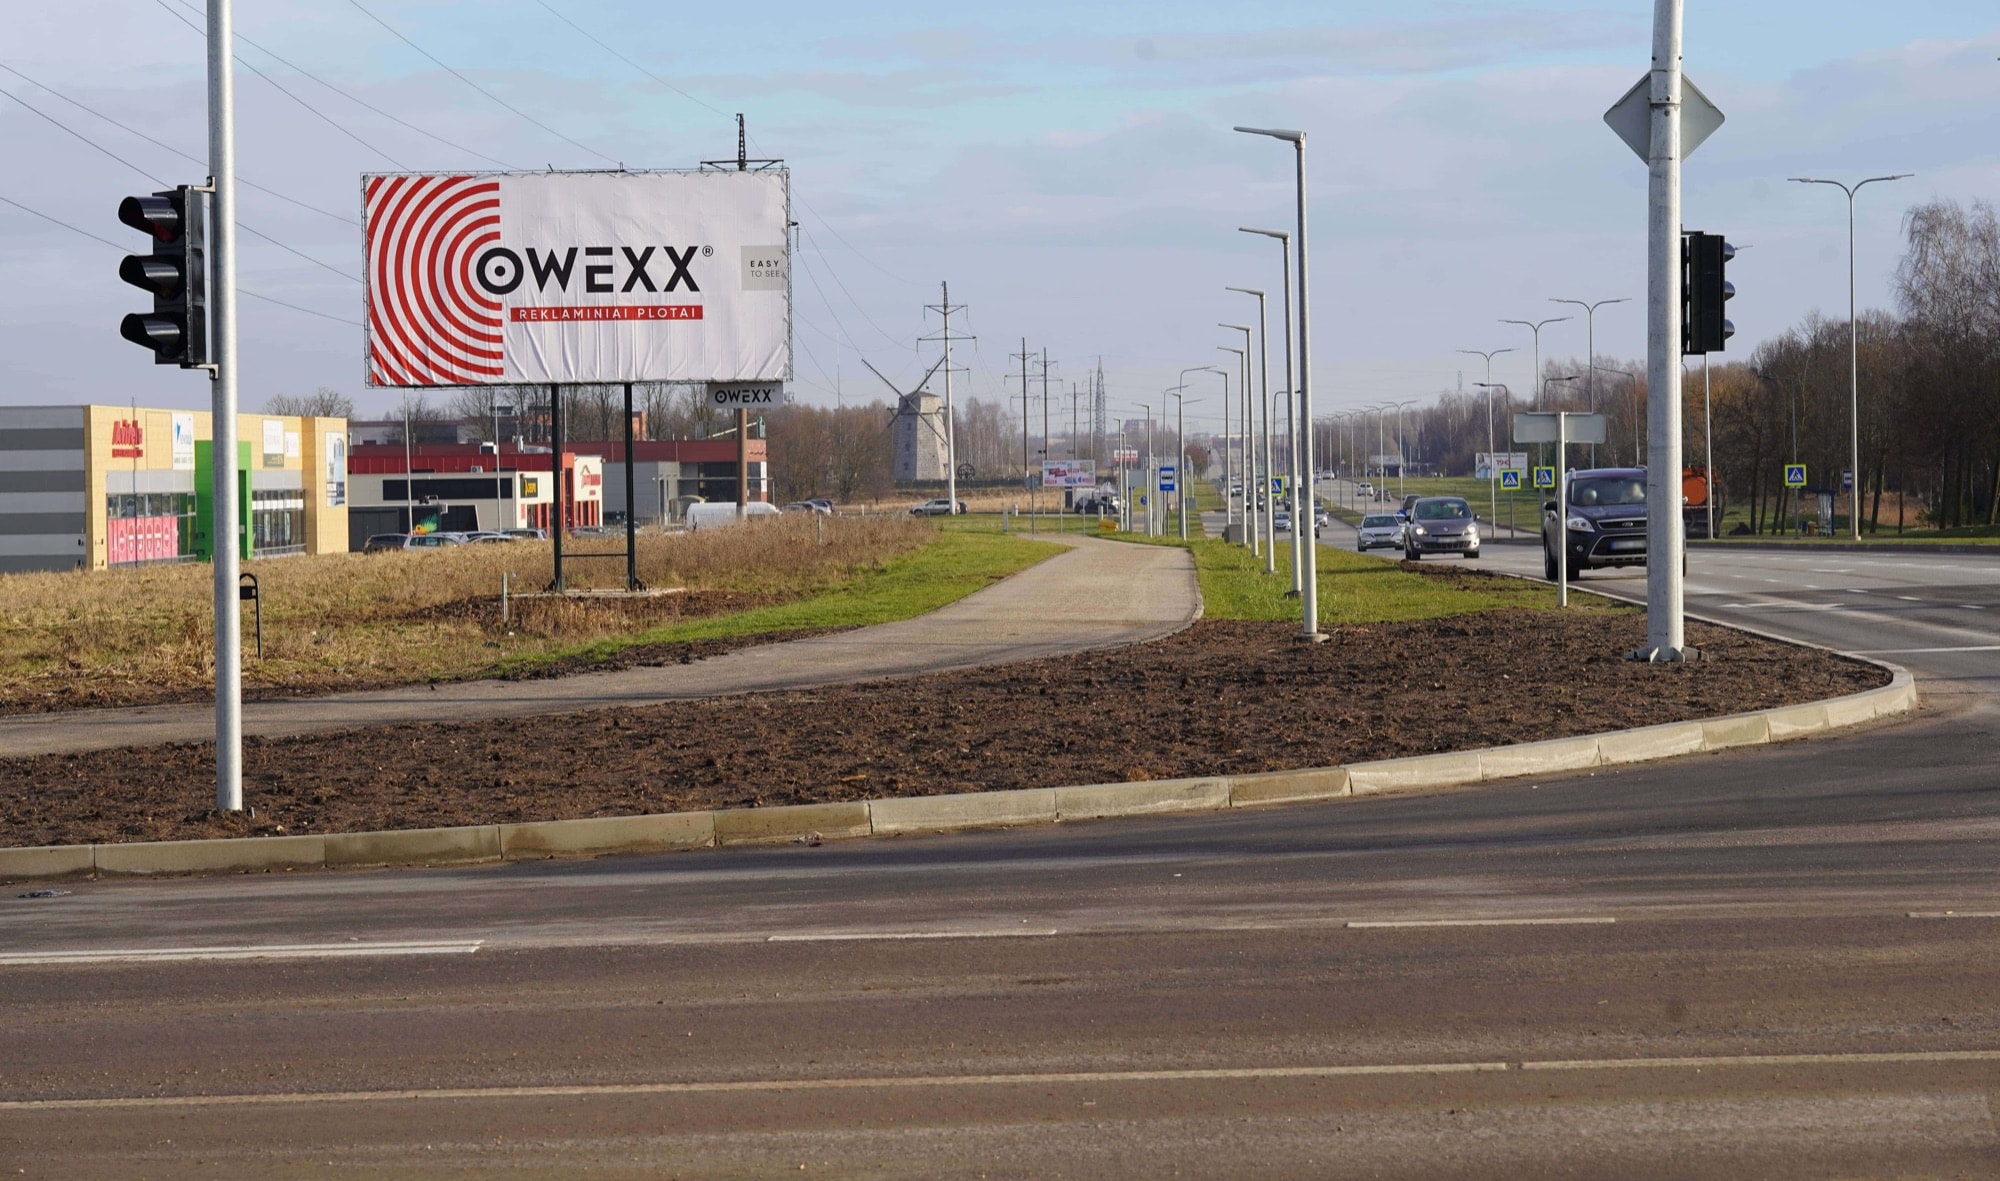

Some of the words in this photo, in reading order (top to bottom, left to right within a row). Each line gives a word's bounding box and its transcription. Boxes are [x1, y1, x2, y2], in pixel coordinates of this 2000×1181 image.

[750, 260, 779, 268] EASY
[750, 270, 762, 278] TO
[765, 270, 780, 278] SEE
[519, 308, 628, 320] REKLAMINIAI
[638, 307, 696, 319] PLOTAI
